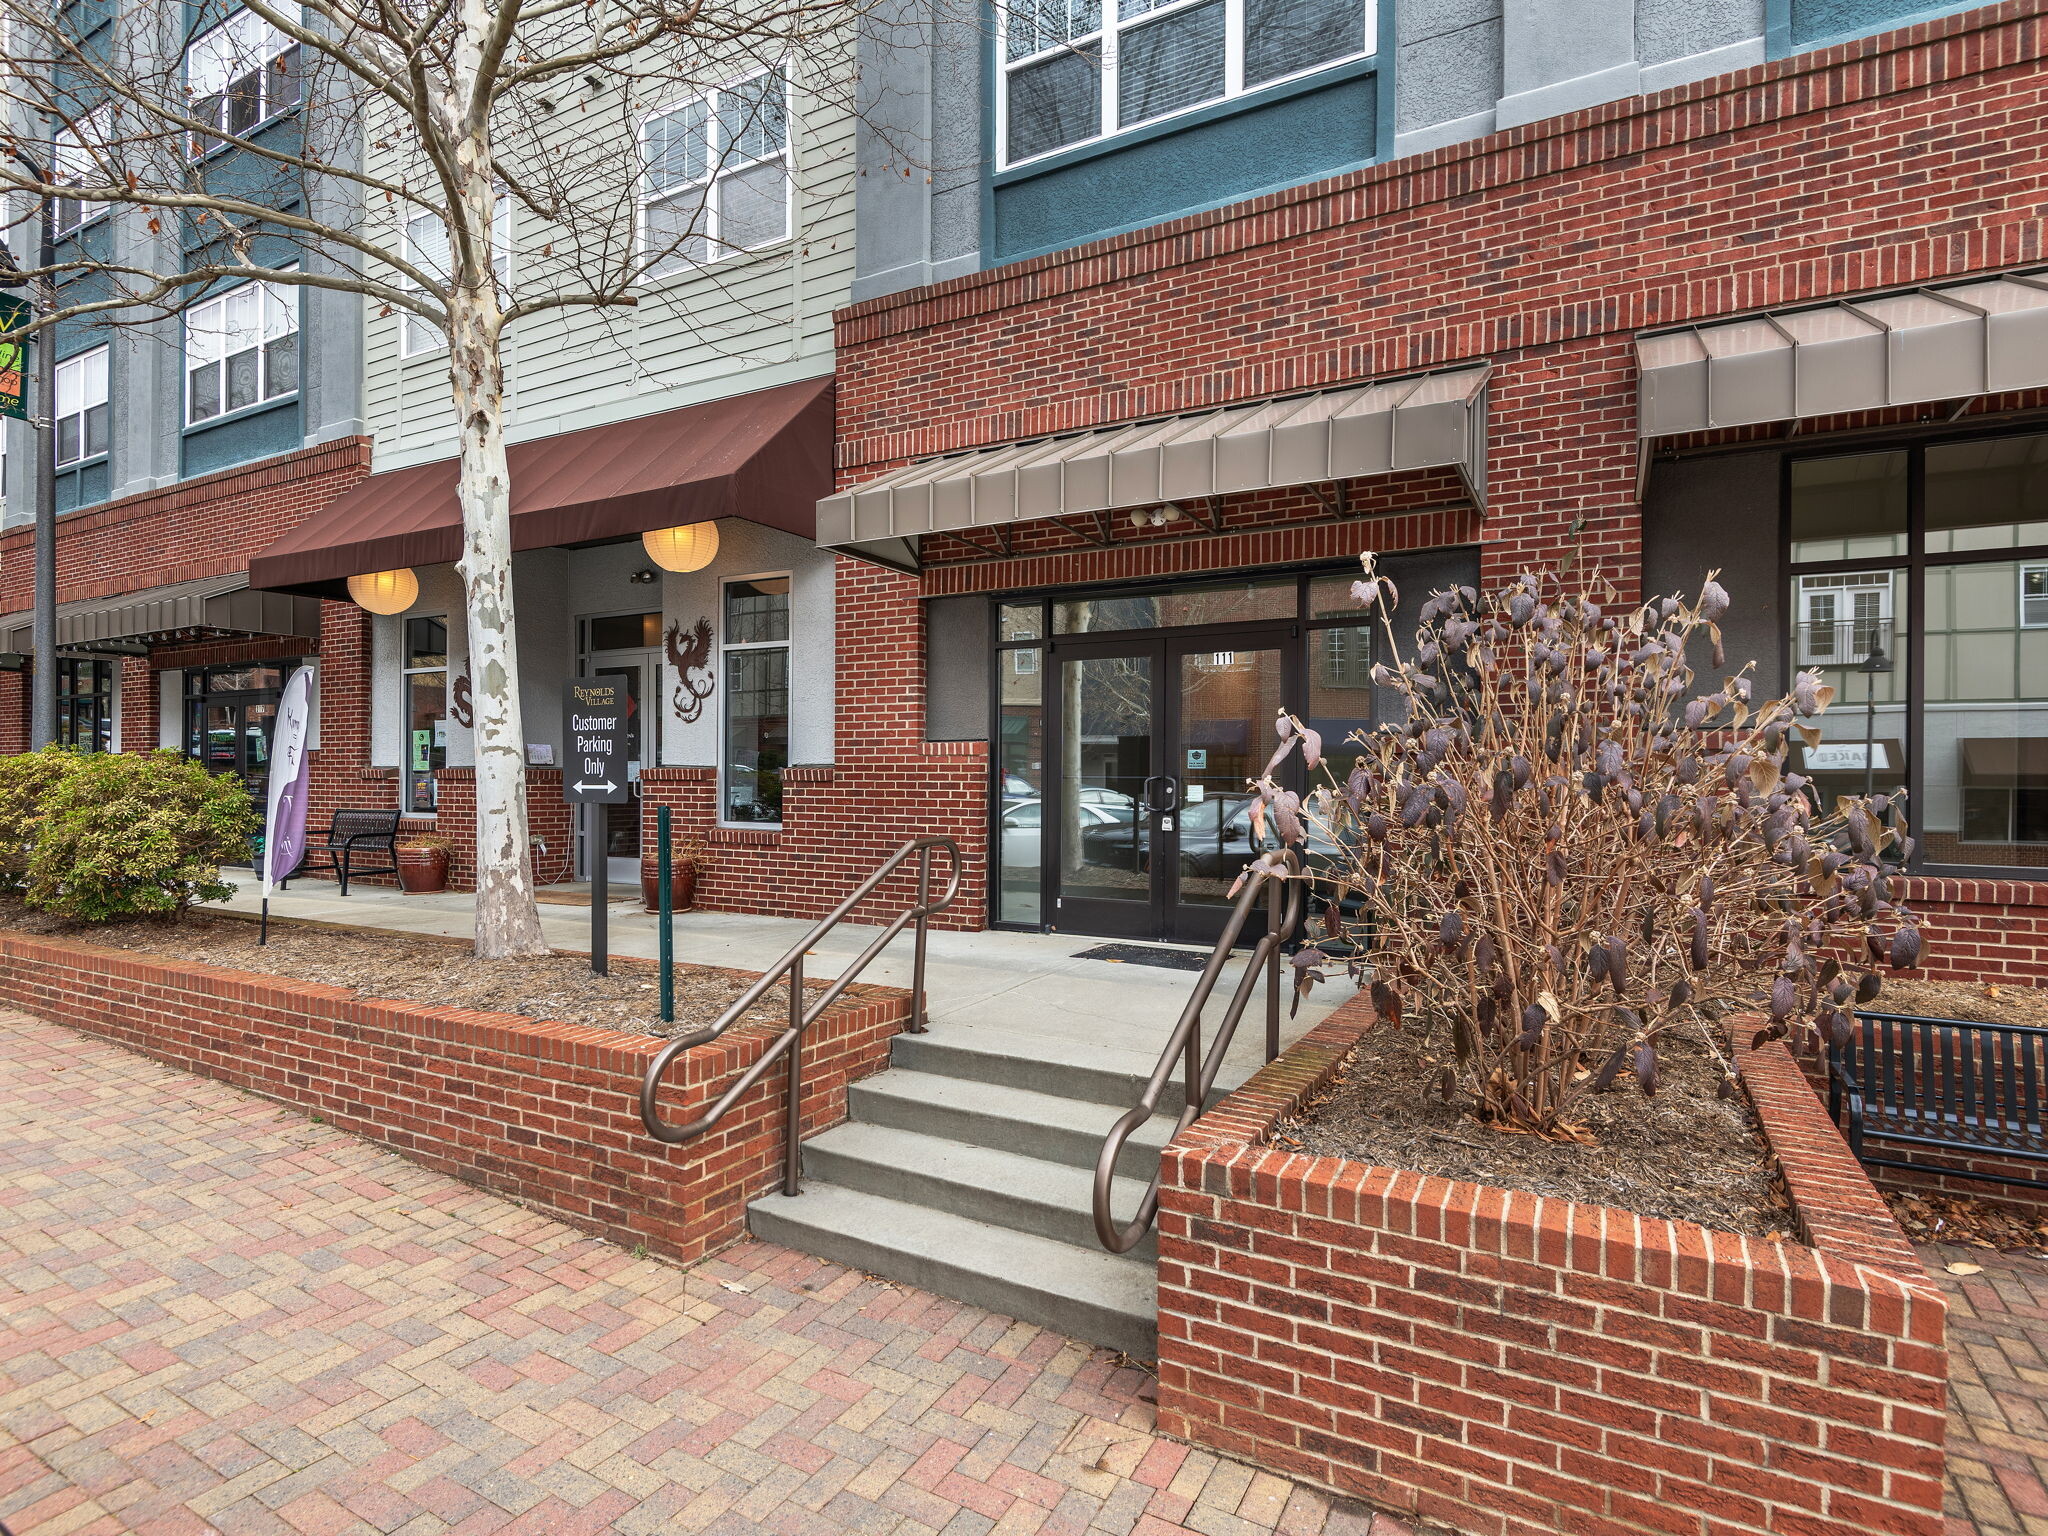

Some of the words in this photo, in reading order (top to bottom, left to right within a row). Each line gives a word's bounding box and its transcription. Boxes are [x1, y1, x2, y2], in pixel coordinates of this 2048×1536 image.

[1215, 651, 1233, 665] 111
[574, 686, 615, 701] REYNOLDS
[586, 697, 615, 707] VILLAGE
[572, 714, 617, 731] Customer
[577, 735, 613, 756] Parking
[584, 757, 605, 778] Only
